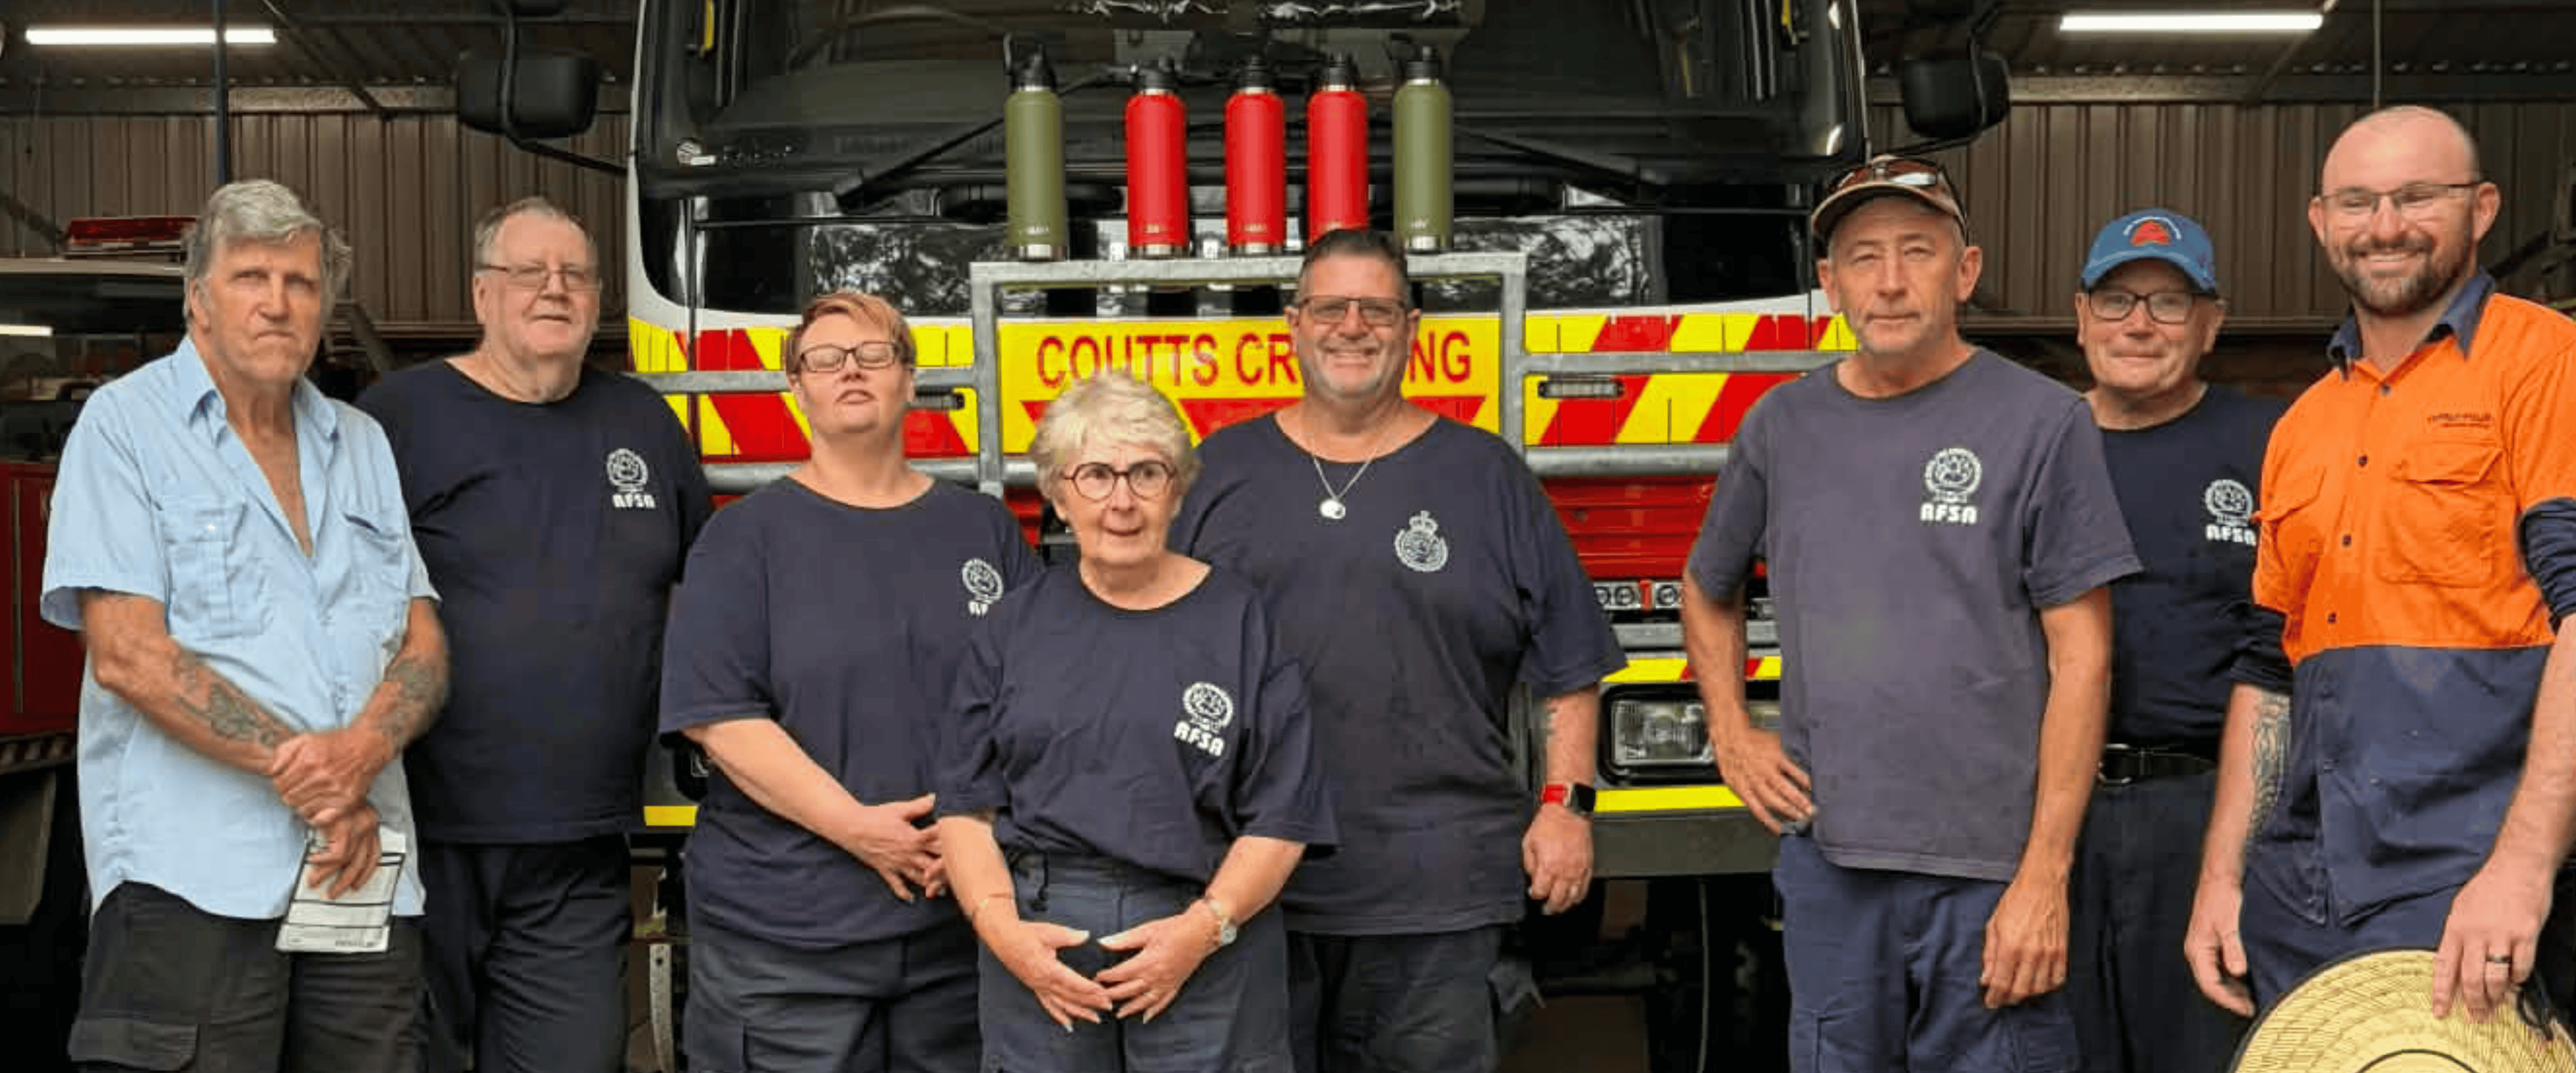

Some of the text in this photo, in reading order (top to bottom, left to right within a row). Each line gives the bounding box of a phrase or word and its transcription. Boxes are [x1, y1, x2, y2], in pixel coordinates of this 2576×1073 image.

[1036, 330, 1471, 388] COUTTS CRNG
[1920, 503, 1978, 525] AFSA
[1174, 721, 1224, 756] AFSA
